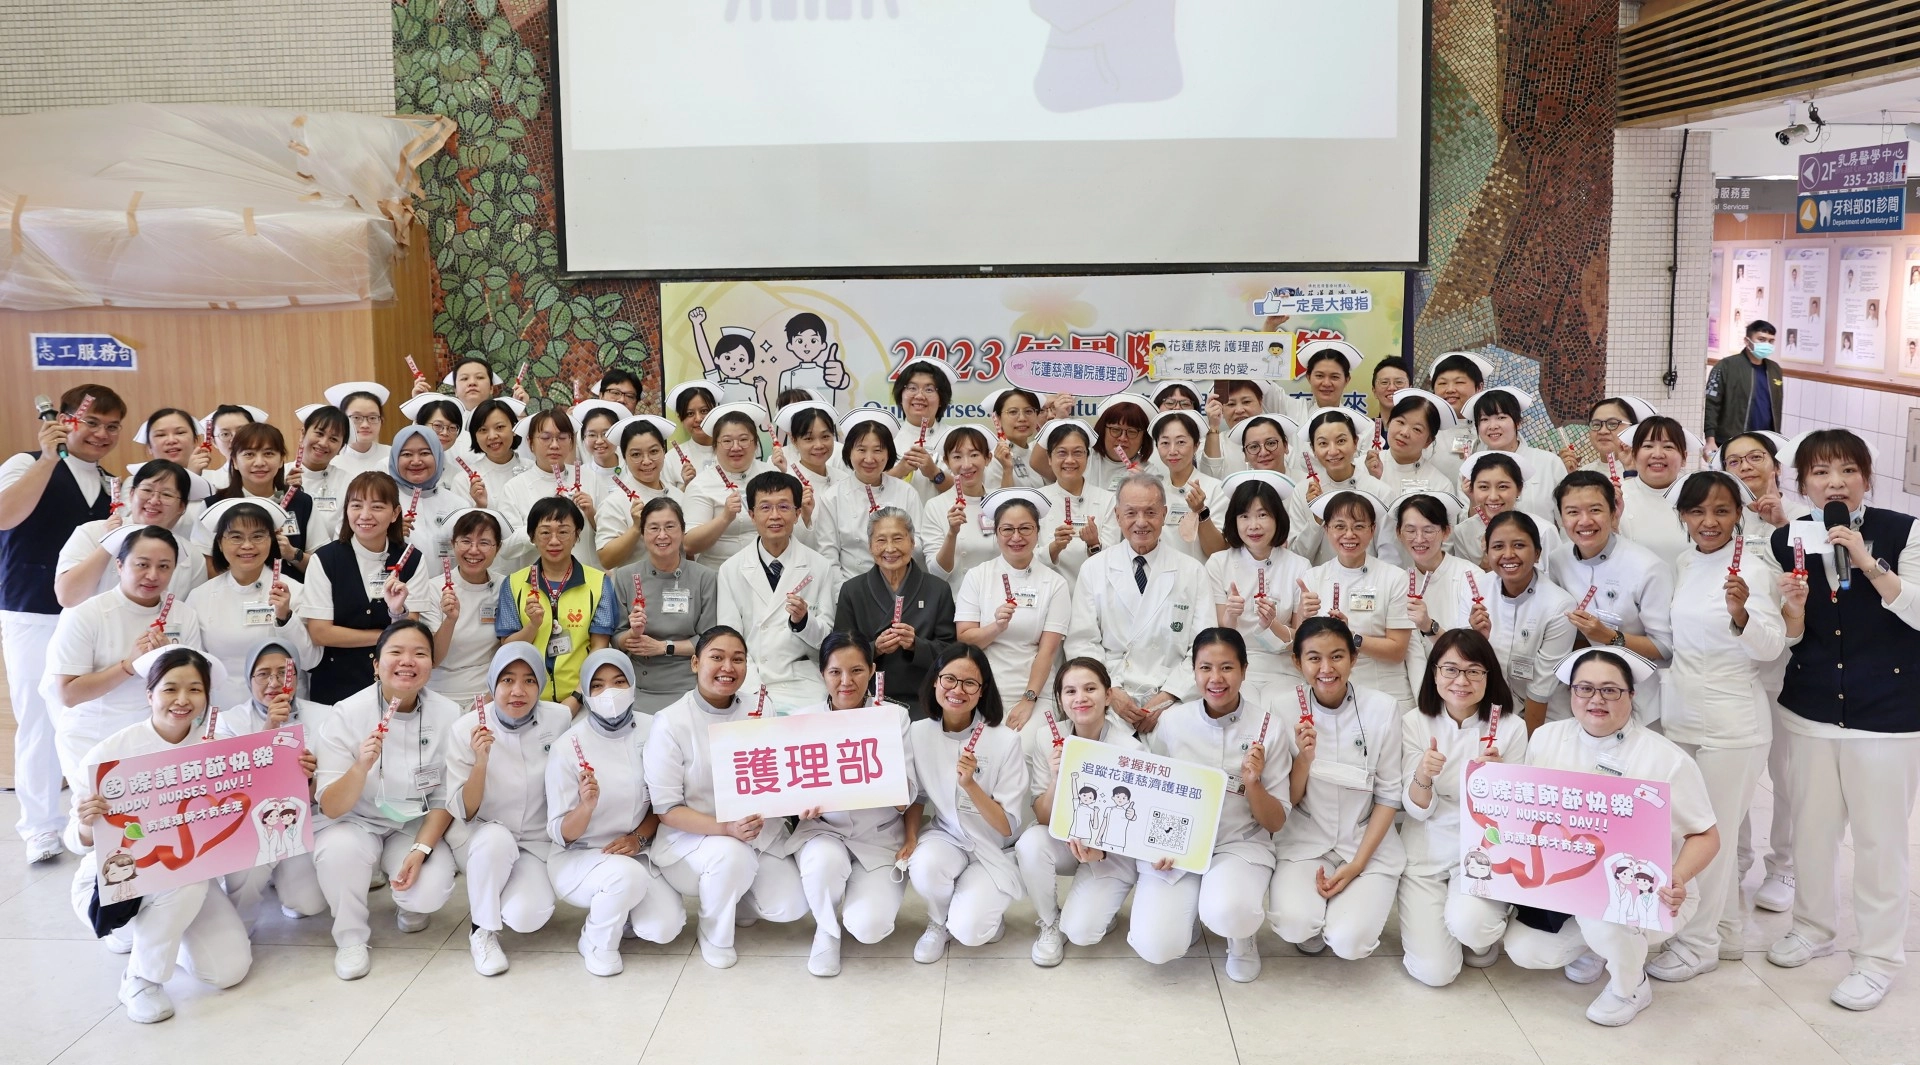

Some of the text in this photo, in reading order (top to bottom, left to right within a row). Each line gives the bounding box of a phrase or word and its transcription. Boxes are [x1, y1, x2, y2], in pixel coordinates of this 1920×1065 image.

[1821, 148, 1905, 181] 2F 乳房醫學中心
[1833, 196, 1899, 216] 牙科部B1診間
[1832, 218, 1860, 226] Department
[1860, 217, 1865, 225] of
[1865, 216, 1889, 225] Dentistry
[1281, 296, 1369, 313] 一定是大拇指
[38, 342, 132, 362] 志工服務台
[1168, 339, 1264, 353] 花蓮慈院 護理部
[1030, 360, 1128, 383] 花蓮慈濟醫院護理部
[102, 745, 274, 799] 國際護師節快樂
[733, 737, 883, 796] 護理部
[1118, 755, 1172, 778] 掌握新知
[158, 785, 208, 805] NURSES
[214, 774, 253, 793] DAY!!
[1081, 761, 1203, 800] 追蹤花蓮慈濟護理部
[1469, 778, 1635, 818] 國際護師節快樂
[146, 801, 244, 832] 有護理師才有未來
[1516, 808, 1562, 825] NURSES
[1569, 816, 1609, 832] DAY!!
[1504, 831, 1596, 856] 有護理師才有未來
